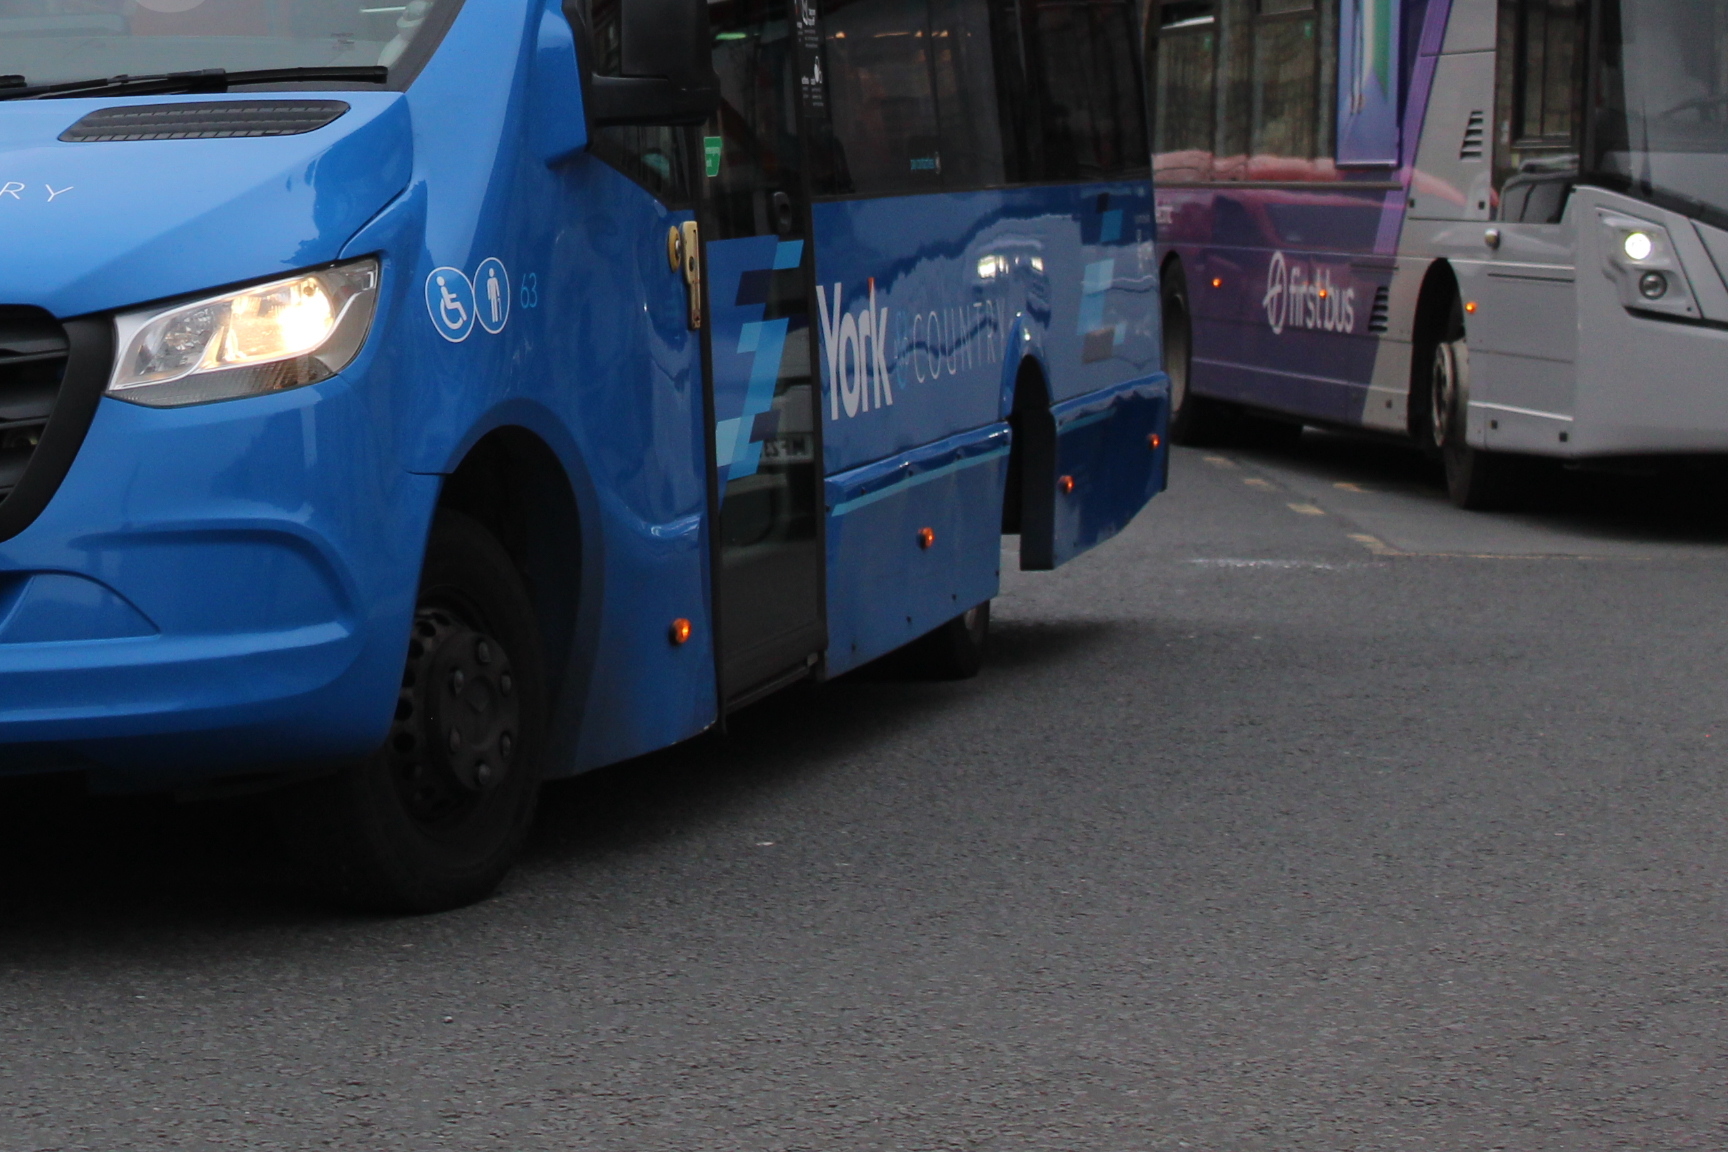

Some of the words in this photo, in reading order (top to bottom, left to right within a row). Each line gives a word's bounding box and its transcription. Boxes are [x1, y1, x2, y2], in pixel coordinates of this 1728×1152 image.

[519, 271, 539, 310] 63
[815, 276, 894, 421] York
[913, 296, 1007, 384] COUNTRY
